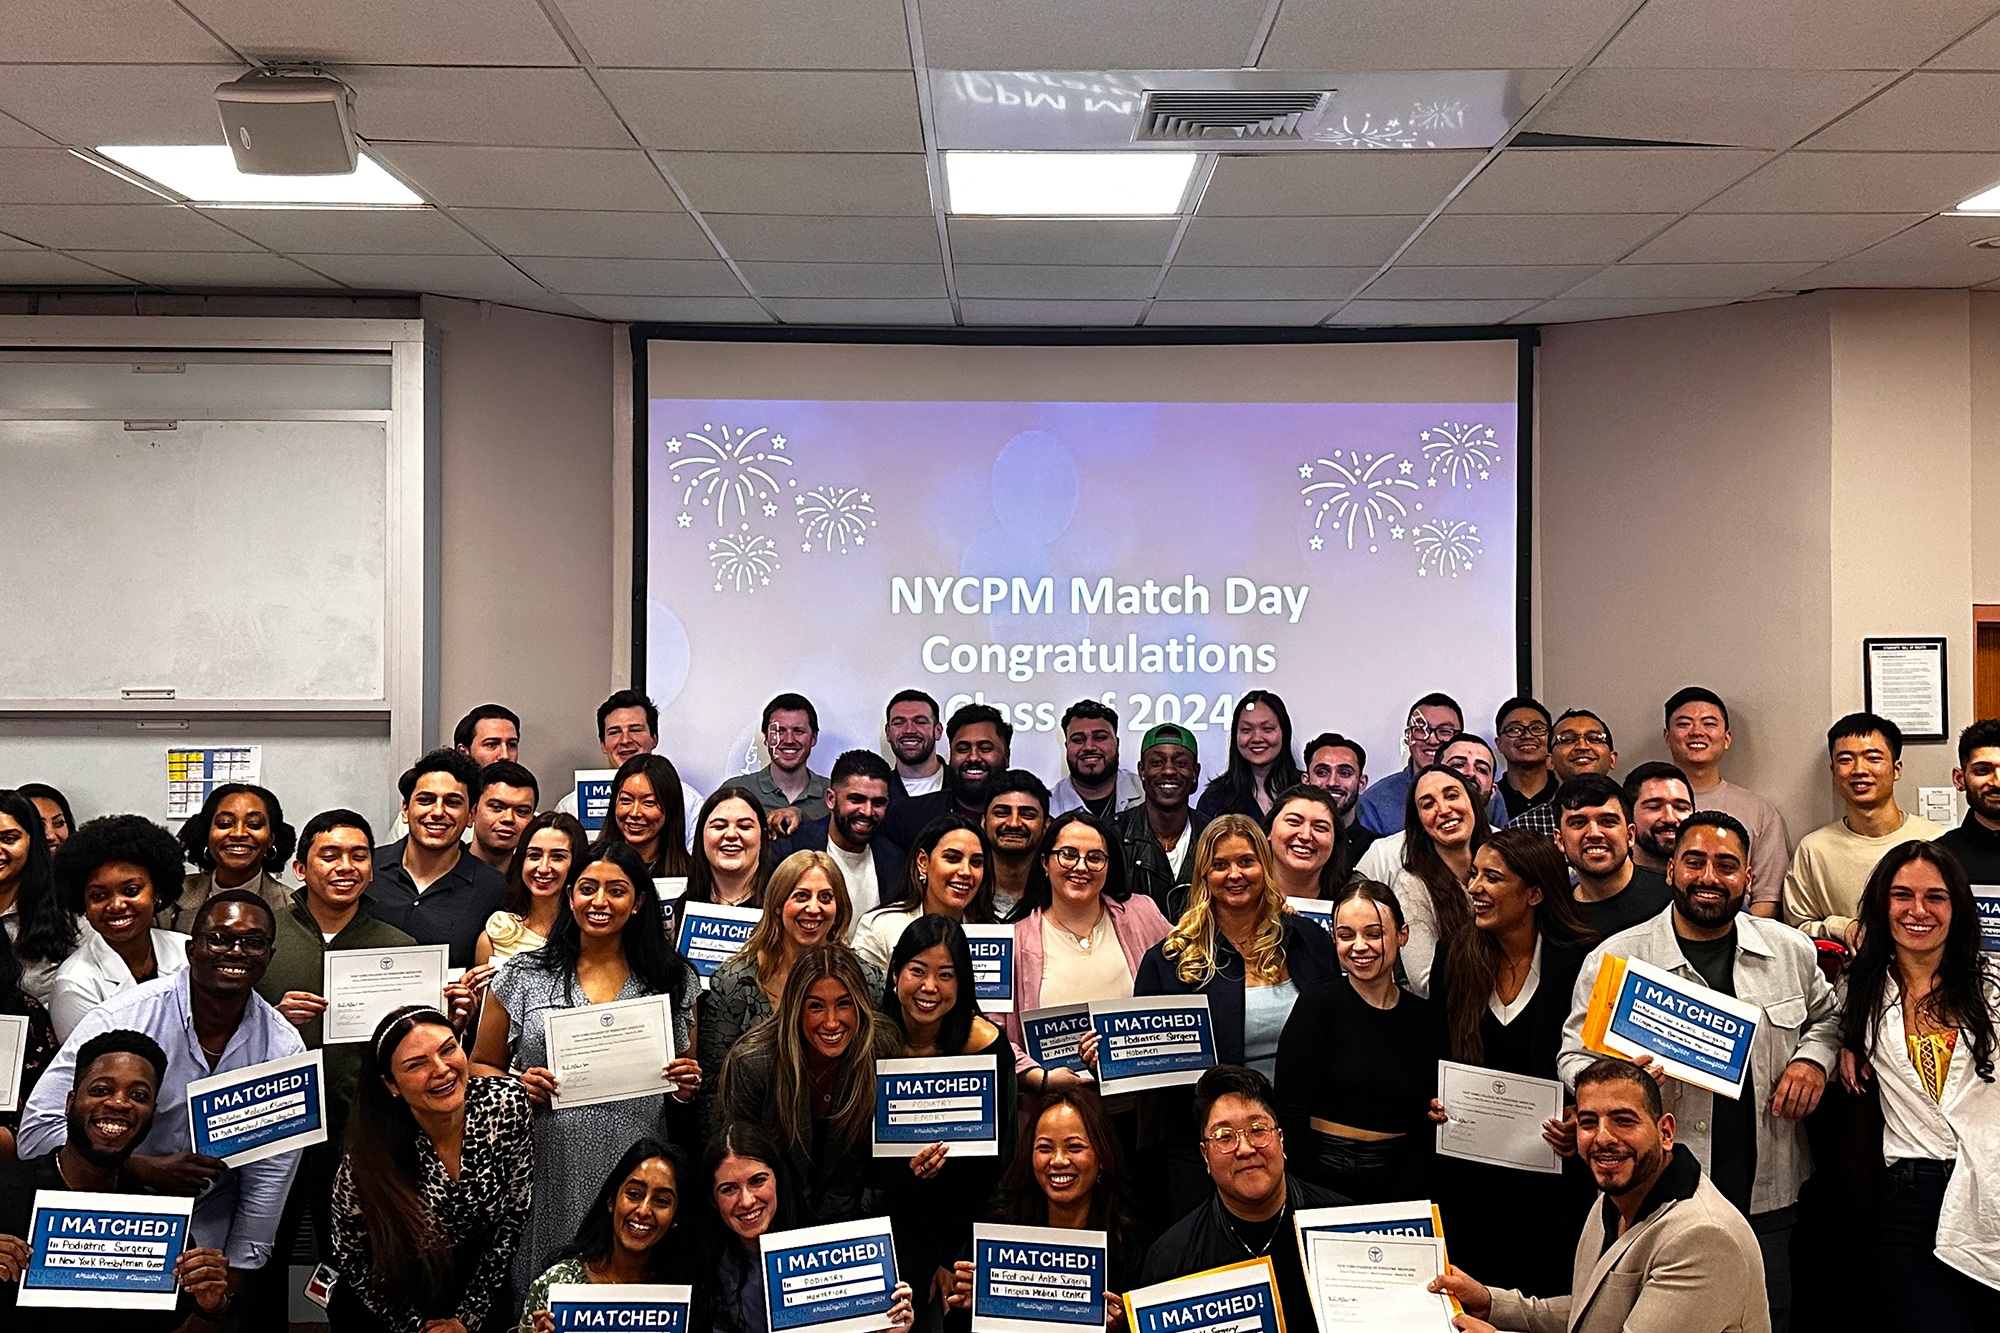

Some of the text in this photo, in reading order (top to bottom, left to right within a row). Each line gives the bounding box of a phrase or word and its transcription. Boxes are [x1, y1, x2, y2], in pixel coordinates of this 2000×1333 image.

[890, 575, 1310, 624] NYCPM Match Day
[922, 634, 1278, 682] Congratulations
[691, 920, 754, 939] I MATCHE
[969, 944, 1006, 956] HED!
[1634, 981, 1642, 995] I
[1645, 986, 1745, 1038] MATCHED!
[1034, 1018, 1089, 1036] I MATC
[1104, 1014, 1202, 1033] I MATCHED!
[1124, 1034, 1161, 1045] Podiatric
[1166, 1032, 1197, 1042] Surgery
[202, 1072, 309, 1114] I MATCHED!
[885, 1077, 987, 1096] I MATCHED!
[912, 1100, 953, 1109] PODIATRY
[914, 1113, 947, 1122] EMORY
[48, 1216, 178, 1237] I MATCHED!
[62, 1240, 106, 1252] Podiatric
[114, 1242, 154, 1256] Surgery
[59, 1257, 76, 1265] New
[99, 1258, 144, 1269] Presbyterian
[776, 1242, 886, 1274] I MATCHED!
[988, 1248, 1096, 1270] I MATCHED!
[804, 1274, 844, 1286] PODIATRY
[992, 1270, 1088, 1287] In Foot and Ankle Surgery
[806, 1288, 848, 1300] MONTEFIORE
[1004, 1286, 1030, 1298] Inspira
[1032, 1289, 1058, 1298] Medical
[1062, 1291, 1087, 1300] Center
[562, 1310, 678, 1326] I MATCHED!
[1150, 1292, 1264, 1331] I MATCHED!
